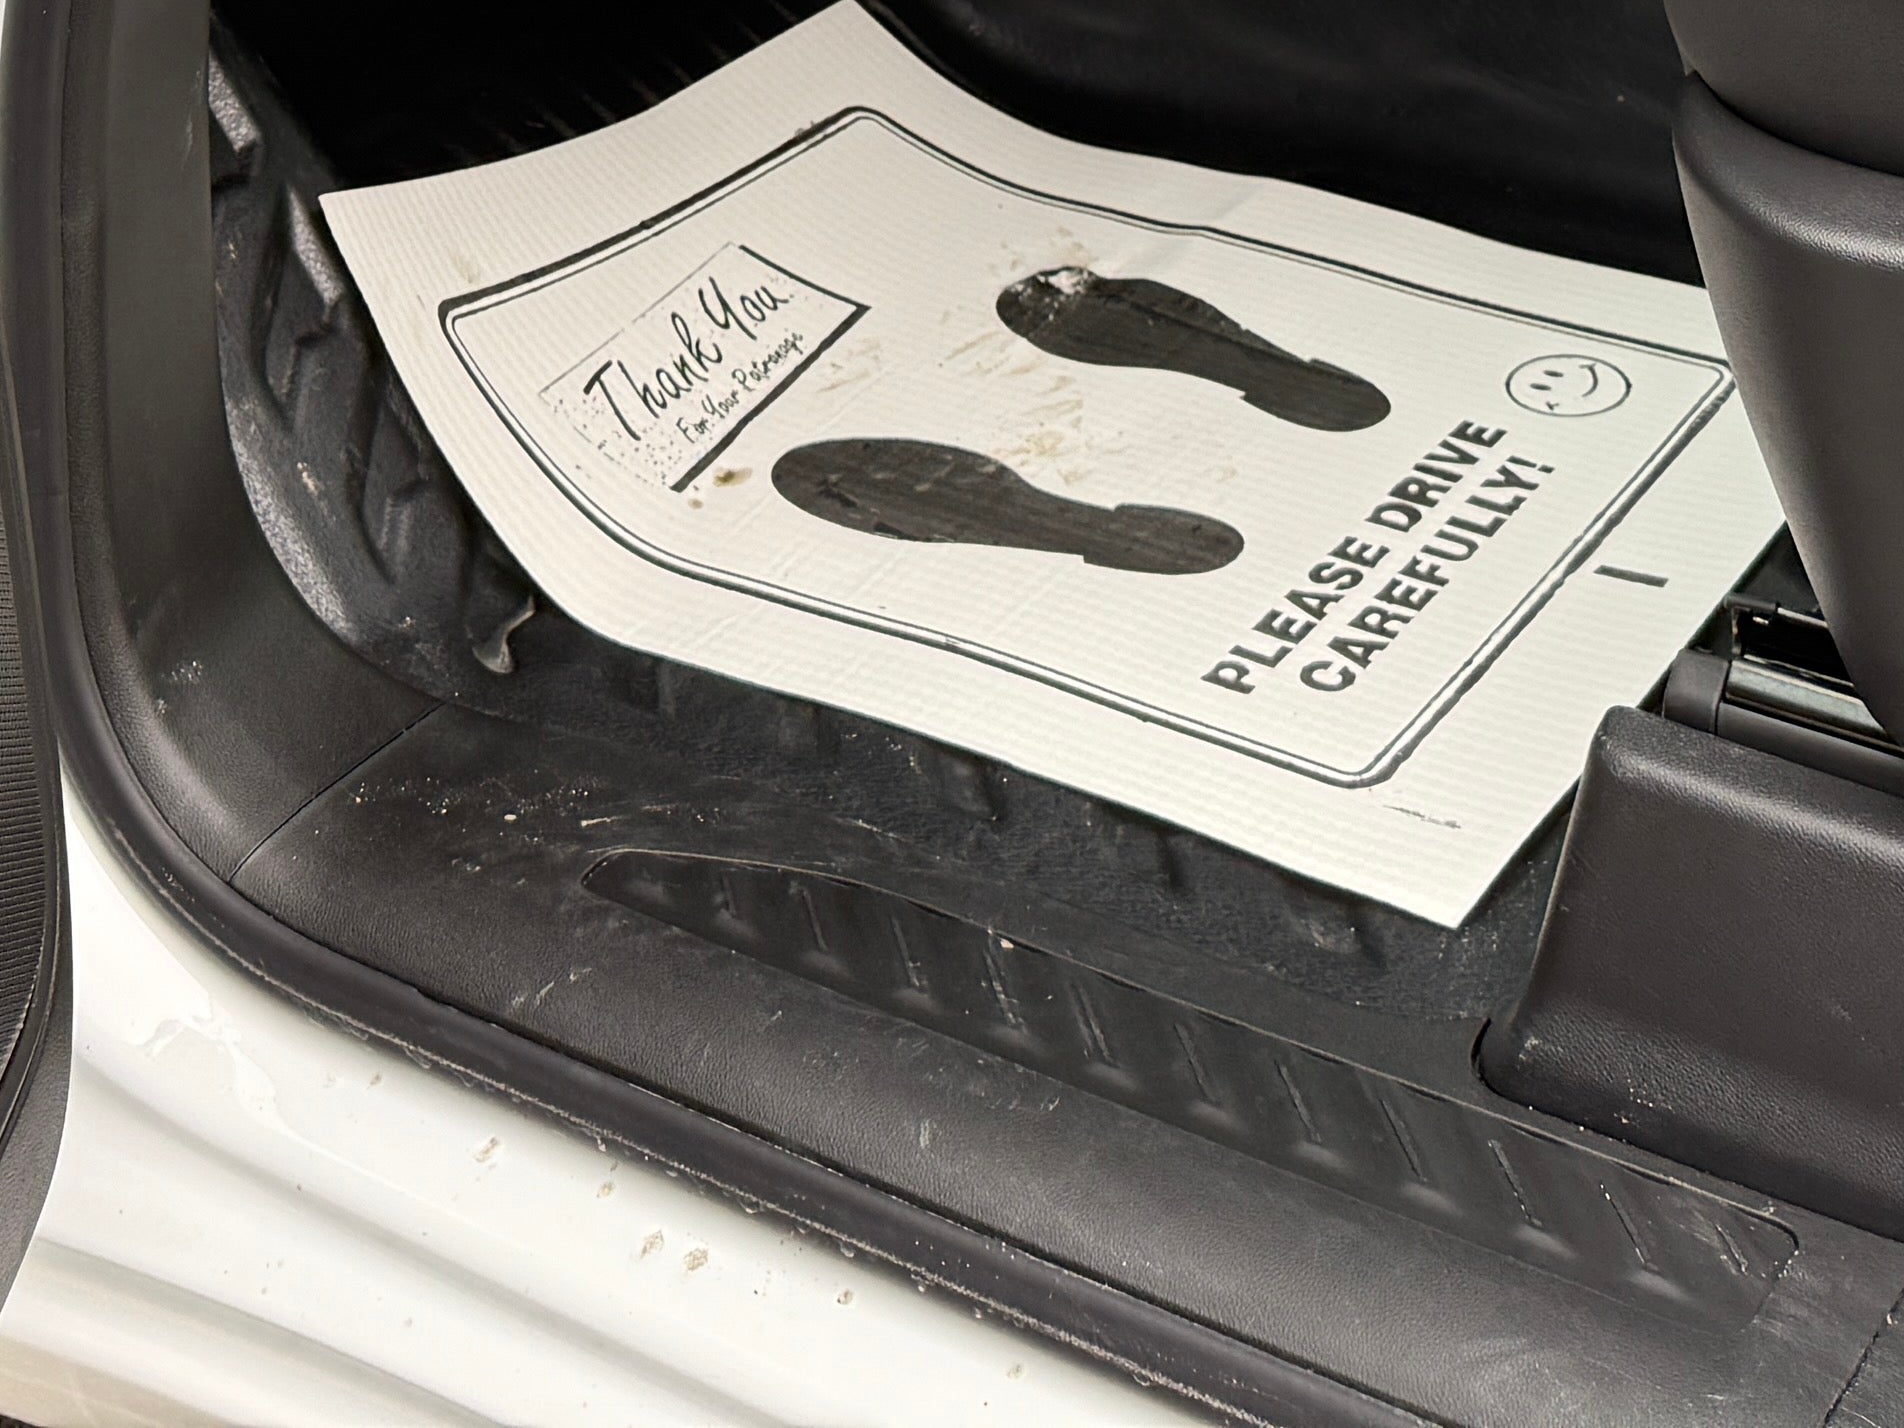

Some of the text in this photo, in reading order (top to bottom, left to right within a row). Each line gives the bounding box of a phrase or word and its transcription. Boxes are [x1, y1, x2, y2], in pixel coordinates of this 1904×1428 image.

[583, 276, 789, 441] Thank You
[676, 332, 803, 444] For Your Patronage
[1200, 419, 1508, 695] PLEASE DRIVE
[1299, 455, 1556, 692] CAREFULLY!
